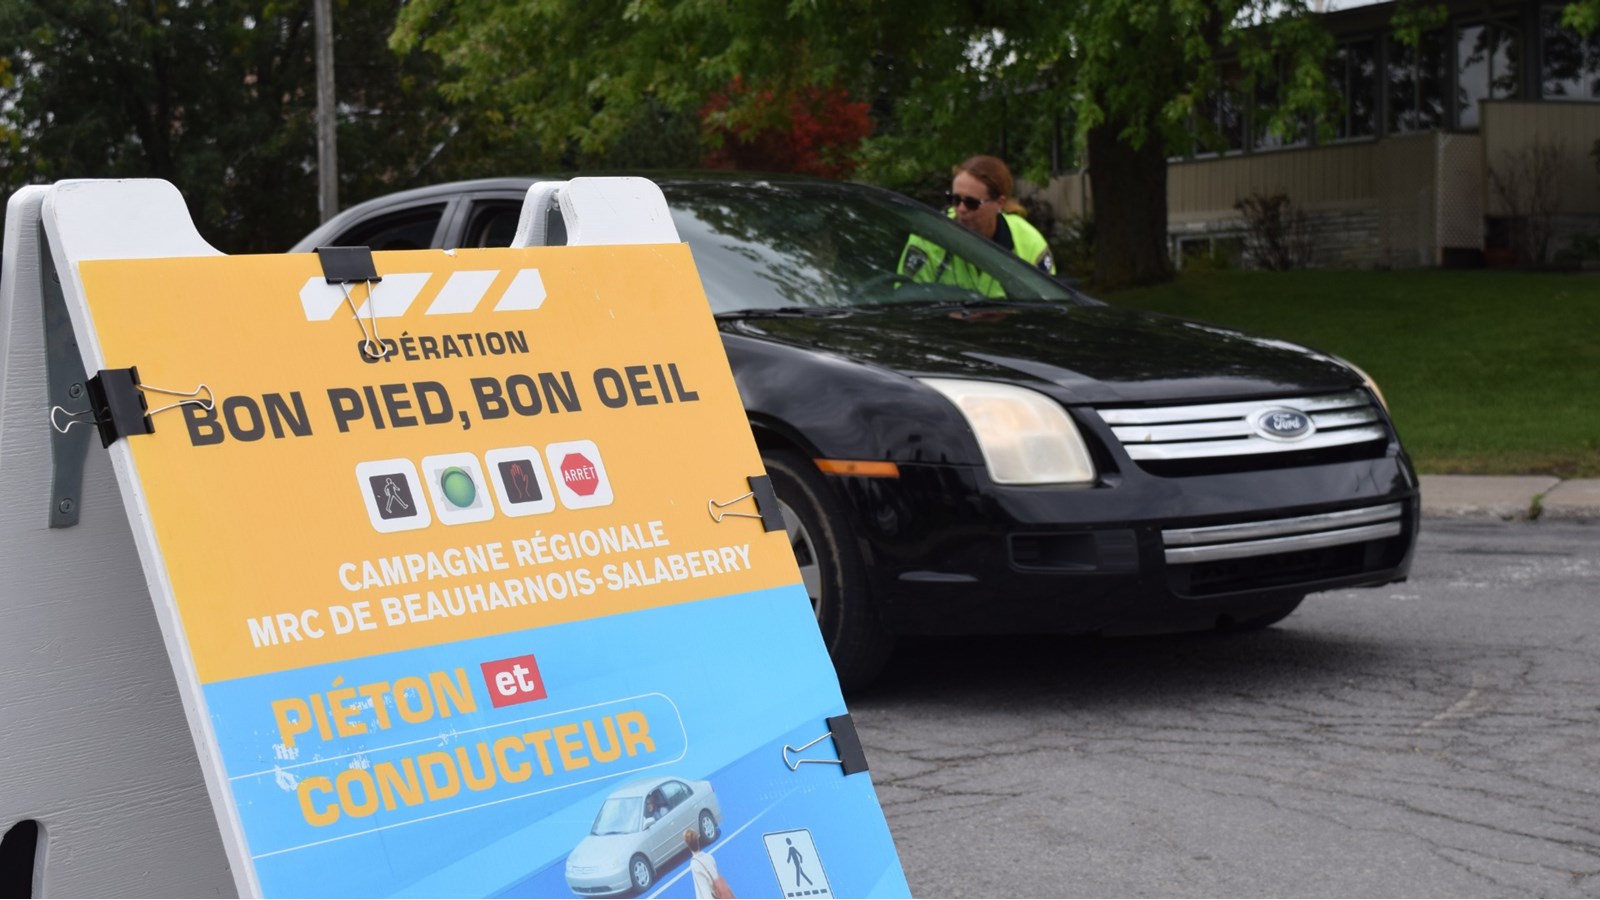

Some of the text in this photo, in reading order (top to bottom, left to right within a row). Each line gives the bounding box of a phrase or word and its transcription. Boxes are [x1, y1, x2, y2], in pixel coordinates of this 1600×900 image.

[357, 330, 530, 364] OPÉRATION
[179, 390, 313, 447] BON
[470, 370, 582, 420] BON
[592, 362, 700, 410] OEIL
[1272, 413, 1301, 430] Ford
[564, 465, 596, 482] ARRÊT
[338, 520, 670, 592] CAMPAGNE RÉGIONALE
[247, 544, 753, 648] MRC DE BEAUHARNOIS-SALABERRY
[270, 663, 535, 748] PIÉTON et
[297, 710, 656, 828] CONDUCTEUR
